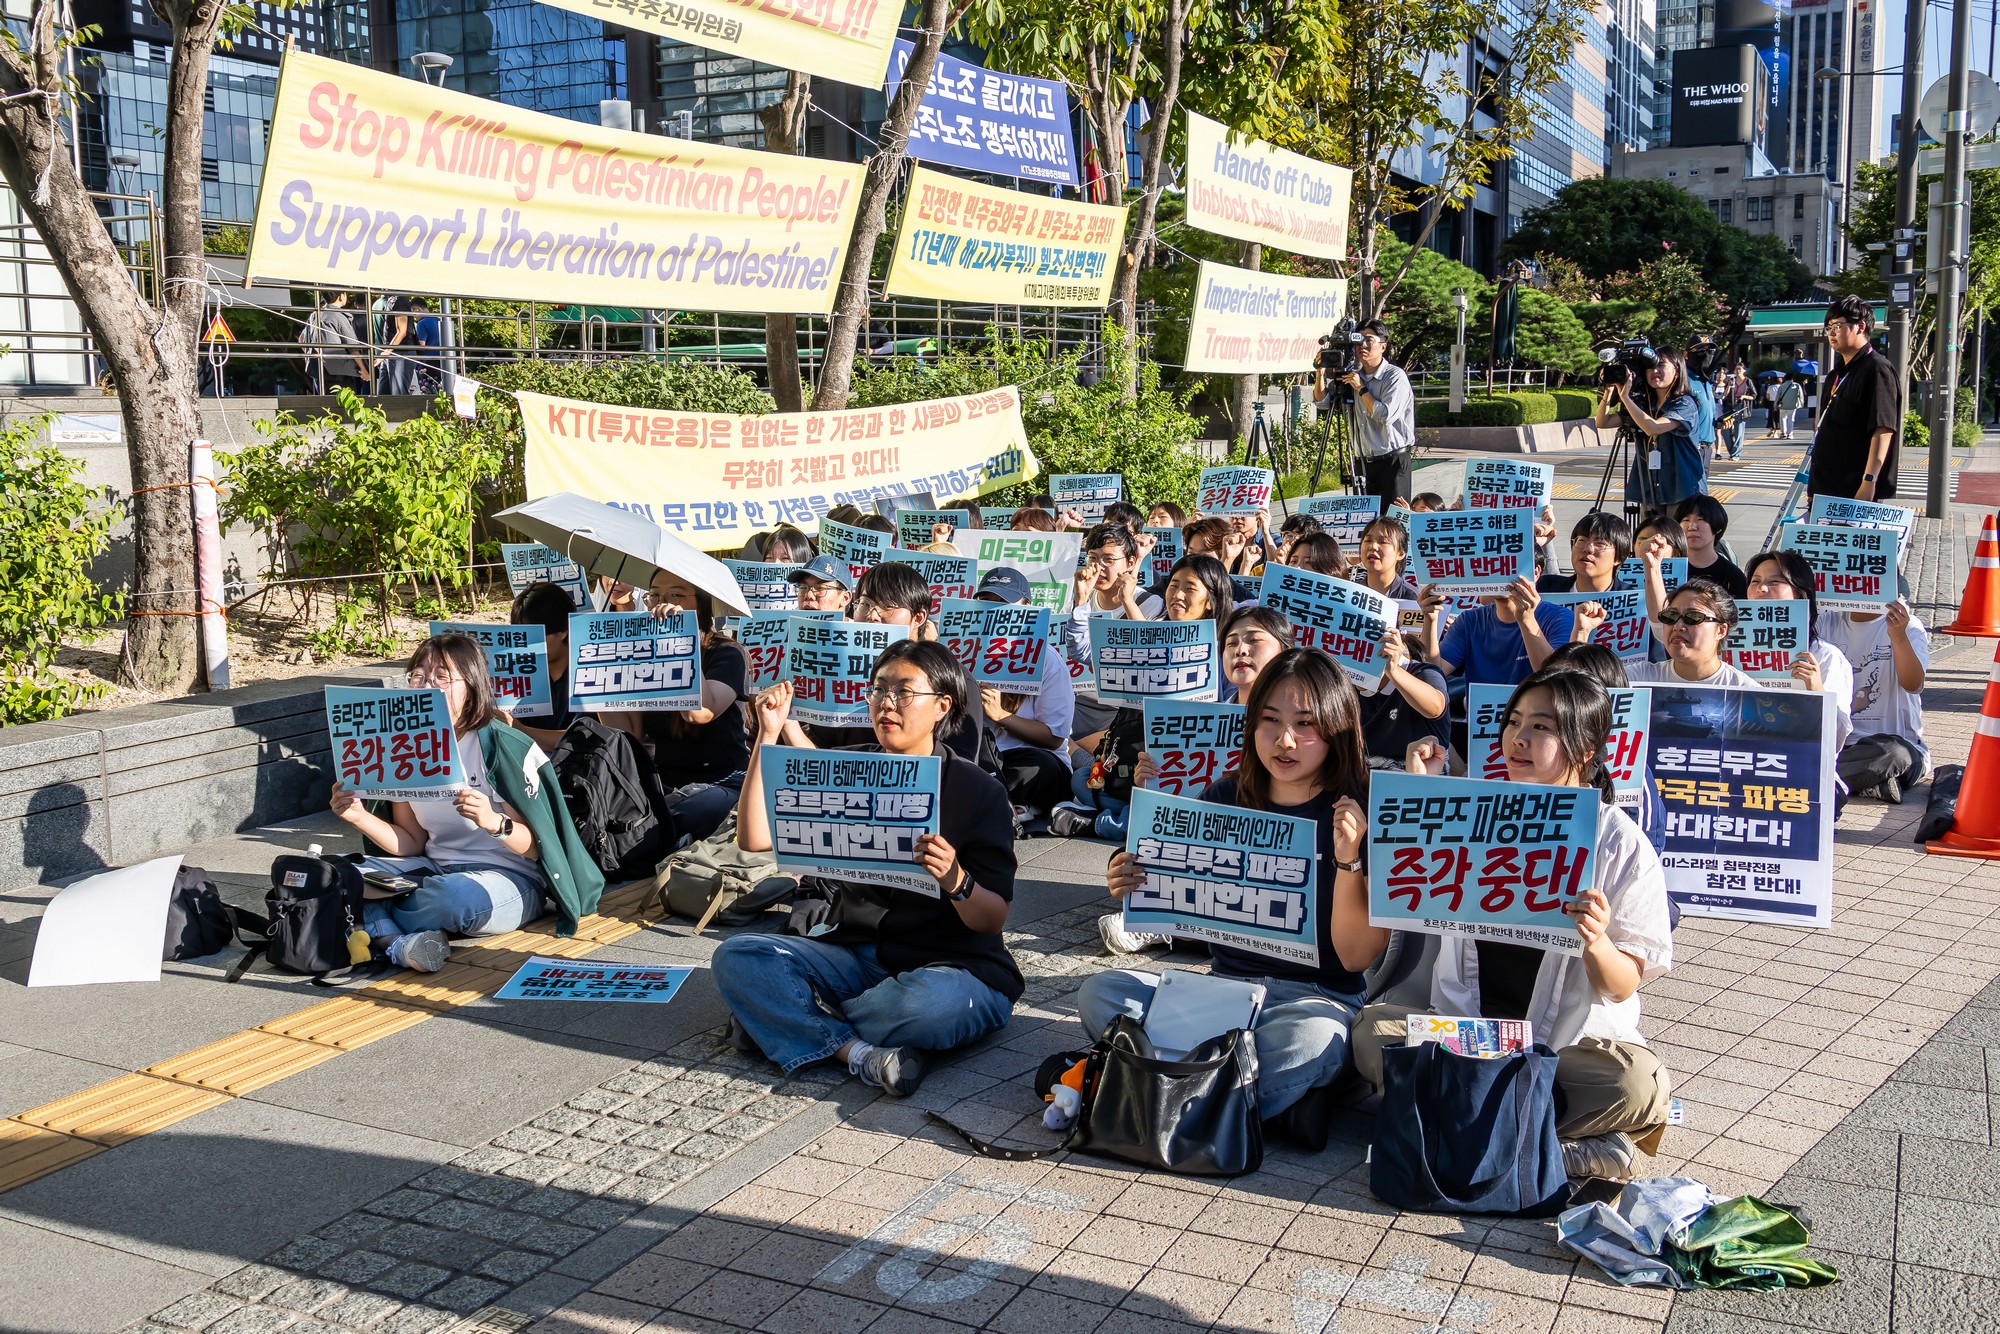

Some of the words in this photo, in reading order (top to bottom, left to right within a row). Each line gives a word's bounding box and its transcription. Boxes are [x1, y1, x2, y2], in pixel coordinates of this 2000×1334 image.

[1861, 13, 1872, 62] 서울신문
[981, 74, 1056, 120] 물리치고
[1683, 86, 1708, 97] THE
[1711, 83, 1749, 95] WHOO
[299, 80, 411, 178] Stop
[416, 108, 537, 203] Killing
[547, 138, 733, 213] Palestinian
[737, 168, 849, 233] People!
[980, 120, 1068, 166] 쟁취하자!!
[1213, 141, 1271, 191] Hands
[1273, 166, 1298, 197] off
[1300, 173, 1332, 207] Cuba
[918, 184, 961, 226] 진정한
[963, 196, 1028, 235] 민주공화국
[1026, 208, 1038, 234] &
[1037, 210, 1086, 241] 민주노조
[1084, 215, 1115, 243] 쟁취!!
[1192, 178, 1250, 224] Unblock
[1288, 209, 1303, 239] No
[1304, 210, 1343, 248] Invasion!
[270, 179, 466, 271] Support
[465, 207, 653, 277] Liberation
[655, 235, 701, 282] of
[693, 244, 839, 292] Palestine!
[959, 237, 1036, 273] 해고자복직!!
[1037, 246, 1106, 278] 헬조선변혁!!
[1204, 327, 1253, 362] Trump,
[1256, 331, 1288, 363] Step
[547, 404, 731, 449] KT(투자운용)은
[740, 416, 799, 449] 힘없는
[805, 416, 824, 443] 한
[829, 410, 884, 443] 가정과
[888, 406, 906, 434] 한
[911, 402, 962, 432] 사람의
[722, 456, 783, 490] 무참히
[790, 453, 845, 486] 짓밟고
[852, 446, 900, 477] 있다!!
[1201, 471, 1233, 491] 호르무즈
[1231, 469, 1267, 486] 파병검토
[1475, 463, 1516, 476] 호르무즈
[1519, 466, 1542, 479] 해협
[663, 501, 738, 531] 무고한
[742, 500, 768, 527] 한
[768, 494, 831, 523] 가정을
[911, 462, 983, 498] 파괴하고
[986, 450, 1021, 480] 있다!
[1054, 489, 1095, 501] 호르무즈
[1096, 488, 1118, 499] 파병
[1202, 488, 1231, 511] 즉각
[1232, 484, 1269, 507] 중단!
[1468, 476, 1510, 494] 한국군
[1514, 480, 1545, 496] 파병
[1470, 492, 1499, 509] 절대
[1826, 502, 1856, 519] 청년들이
[904, 515, 937, 526] 호르무즈
[1425, 517, 1483, 533] 호르무즈
[1487, 514, 1517, 531] 해협
[825, 524, 853, 542] 호르무즈
[857, 533, 879, 548] 해협
[1417, 536, 1477, 558] 한국군
[1482, 533, 1524, 555] 파병
[1795, 530, 1848, 547] 호르무즈
[1852, 534, 1880, 550] 해협
[850, 548, 882, 565] 파병
[978, 538, 1053, 563] 미국의
[1845, 553, 1886, 575] 파병
[737, 567, 762, 581] 청년들이
[924, 560, 968, 584] 파병검토
[1426, 558, 1465, 579] 절대
[1470, 555, 1517, 577] 반대!
[1280, 574, 1347, 603] 호르무즈
[1350, 591, 1383, 615] 해협
[1831, 573, 1880, 595] 반대!
[940, 610, 984, 637] 호르무즈
[982, 609, 1039, 637] 파병검토
[1266, 592, 1334, 629] 한국군
[1339, 611, 1386, 641] 파병
[1757, 606, 1789, 622] 해협
[497, 632, 527, 648] 해협
[589, 619, 623, 640] 청년들이
[797, 626, 848, 647] 호르무즈
[854, 631, 889, 649] 해협
[1107, 626, 1138, 646] 청년들이
[1140, 624, 1199, 645] 방패막이인가?!
[1752, 626, 1797, 649] 파병
[578, 640, 652, 663] 호르무즈
[655, 636, 695, 657] 파병
[983, 637, 1044, 675] 중단!
[1100, 647, 1168, 666] 호르무즈
[1170, 644, 1211, 664] 파병
[1321, 631, 1375, 664] 반대!
[1739, 650, 1789, 671] 반대!
[494, 652, 537, 674] 파병
[790, 647, 840, 677] 한국군
[573, 659, 695, 696] 반대한다
[792, 675, 825, 703] 절대
[1099, 664, 1211, 693] 반대한다
[332, 700, 376, 737] 호르무즈
[379, 692, 435, 733] 파병검토
[1148, 715, 1214, 749] 호르무즈
[341, 736, 386, 786] 즉각
[390, 728, 451, 781] 중단!
[1655, 746, 1788, 779] 호르무즈
[785, 759, 829, 787] 청년들이
[833, 759, 919, 788] 방패막이인가?!
[1158, 750, 1218, 796] 즉각
[775, 788, 872, 818] 호르무즈
[875, 792, 933, 821] 파병
[1742, 784, 1810, 814] 파병
[1152, 805, 1201, 840] 청년들이
[1203, 812, 1295, 850] 방패막이인가?!
[1373, 797, 1471, 845] 호르무즈
[1468, 792, 1578, 844] 파병검토
[775, 819, 930, 862] 반대한다
[1138, 838, 1243, 879] 호르무즈
[1246, 851, 1309, 886] 파병
[1662, 857, 1718, 871] 이스라엘
[1723, 860, 1781, 875] 침략전쟁
[817, 865, 842, 877] 호르무즈
[843, 868, 857, 879] 파병
[858, 870, 885, 882] 절대반대
[886, 874, 912, 886] 청년학생
[913, 877, 937, 893] 긴급집회
[1386, 846, 1472, 913] 즉각
[1477, 844, 1589, 915] 중단!
[1706, 873, 1747, 892] 참전
[1754, 876, 1801, 895] 반대!
[1130, 872, 1305, 933] 반대한다
[1175, 922, 1204, 936] 호르무즈
[1205, 928, 1220, 940] 파병
[1221, 932, 1251, 946] 절대반대
[1252, 940, 1282, 953] 청년학생
[1284, 945, 1314, 961] 긴급집회
[1423, 918, 1457, 932] 호르무즈
[1458, 921, 1476, 933] 파병
[1477, 924, 1513, 938] 절대반대
[1515, 928, 1550, 944] 청년학생
[1551, 933, 1582, 951] 긴급집회
[520, 977, 581, 990] 파병
[539, 968, 605, 980] 반대!
